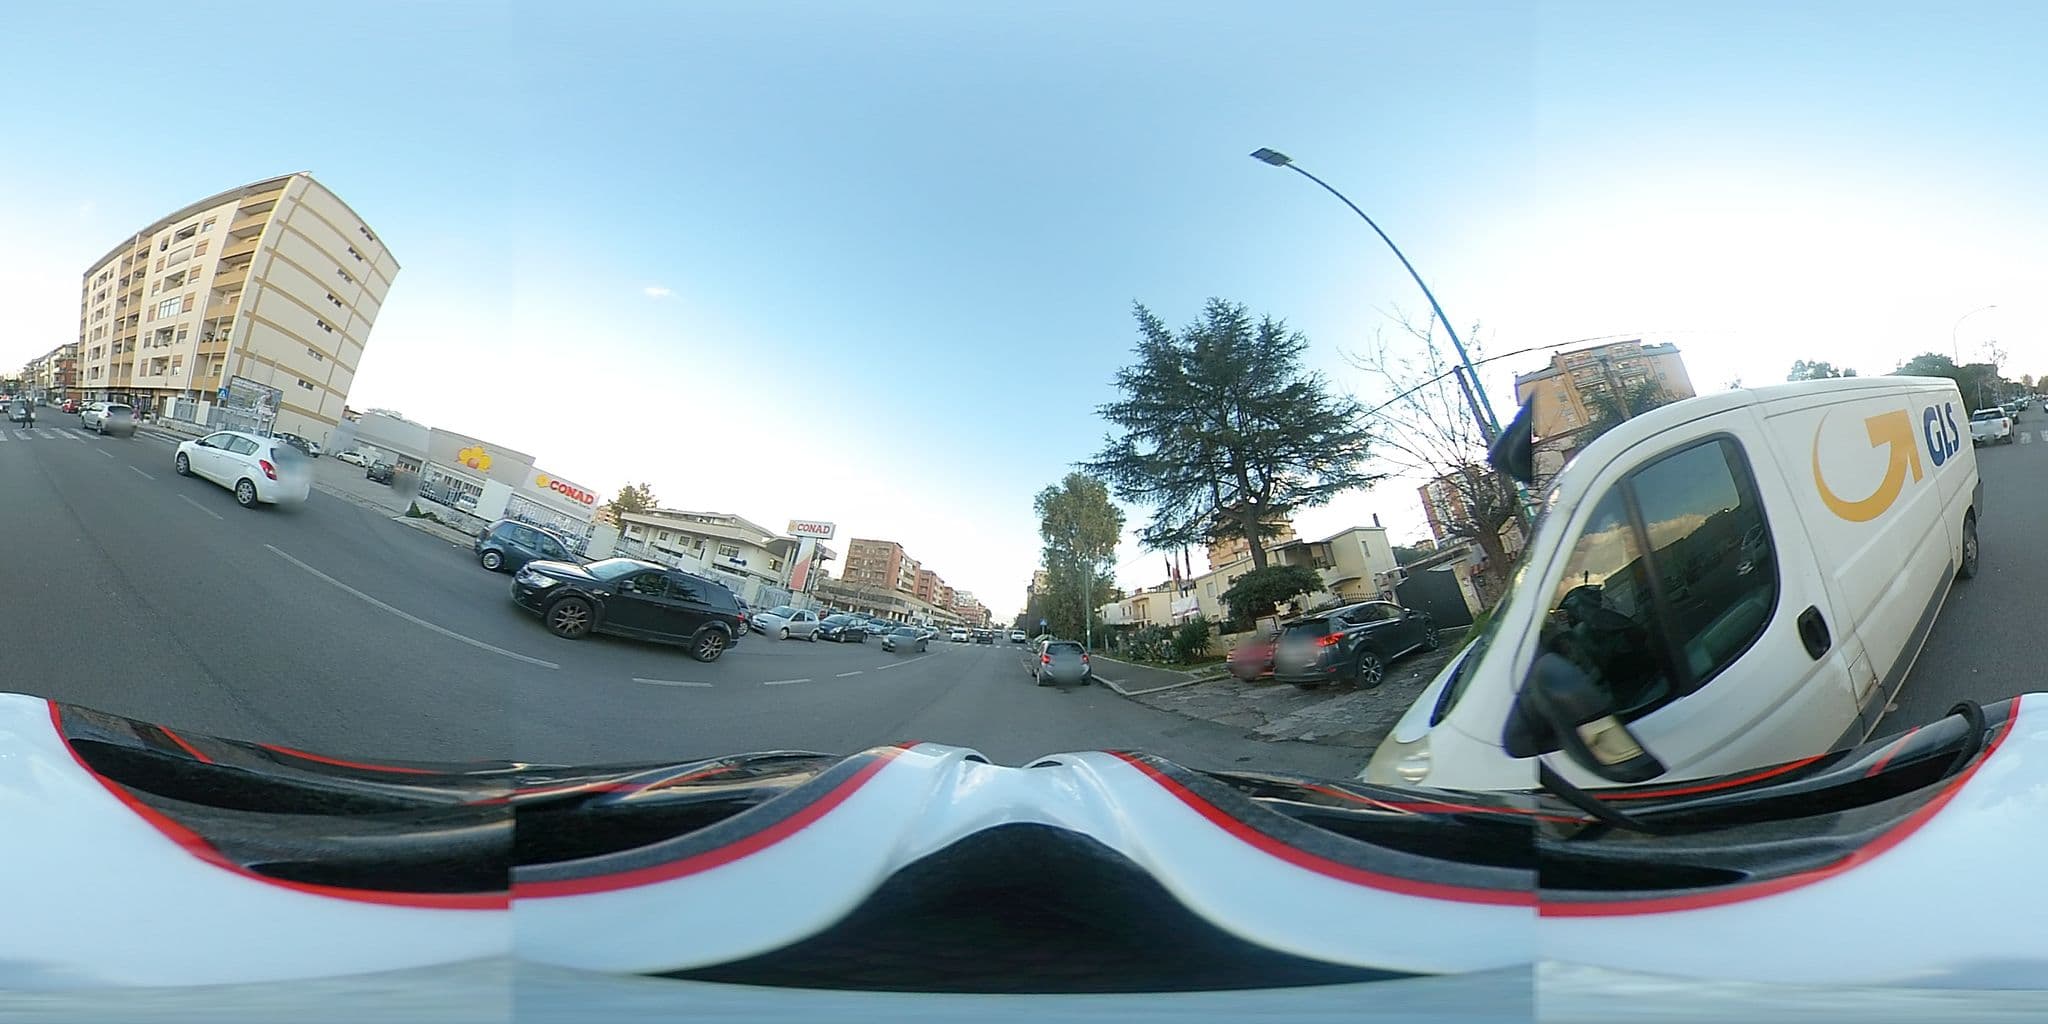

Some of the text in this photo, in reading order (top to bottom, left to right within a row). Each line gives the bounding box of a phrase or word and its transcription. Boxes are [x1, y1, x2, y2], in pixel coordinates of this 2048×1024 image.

[1923, 402, 1960, 466] GLS
[550, 480, 594, 504] CONAD
[797, 523, 831, 534] CONAD
